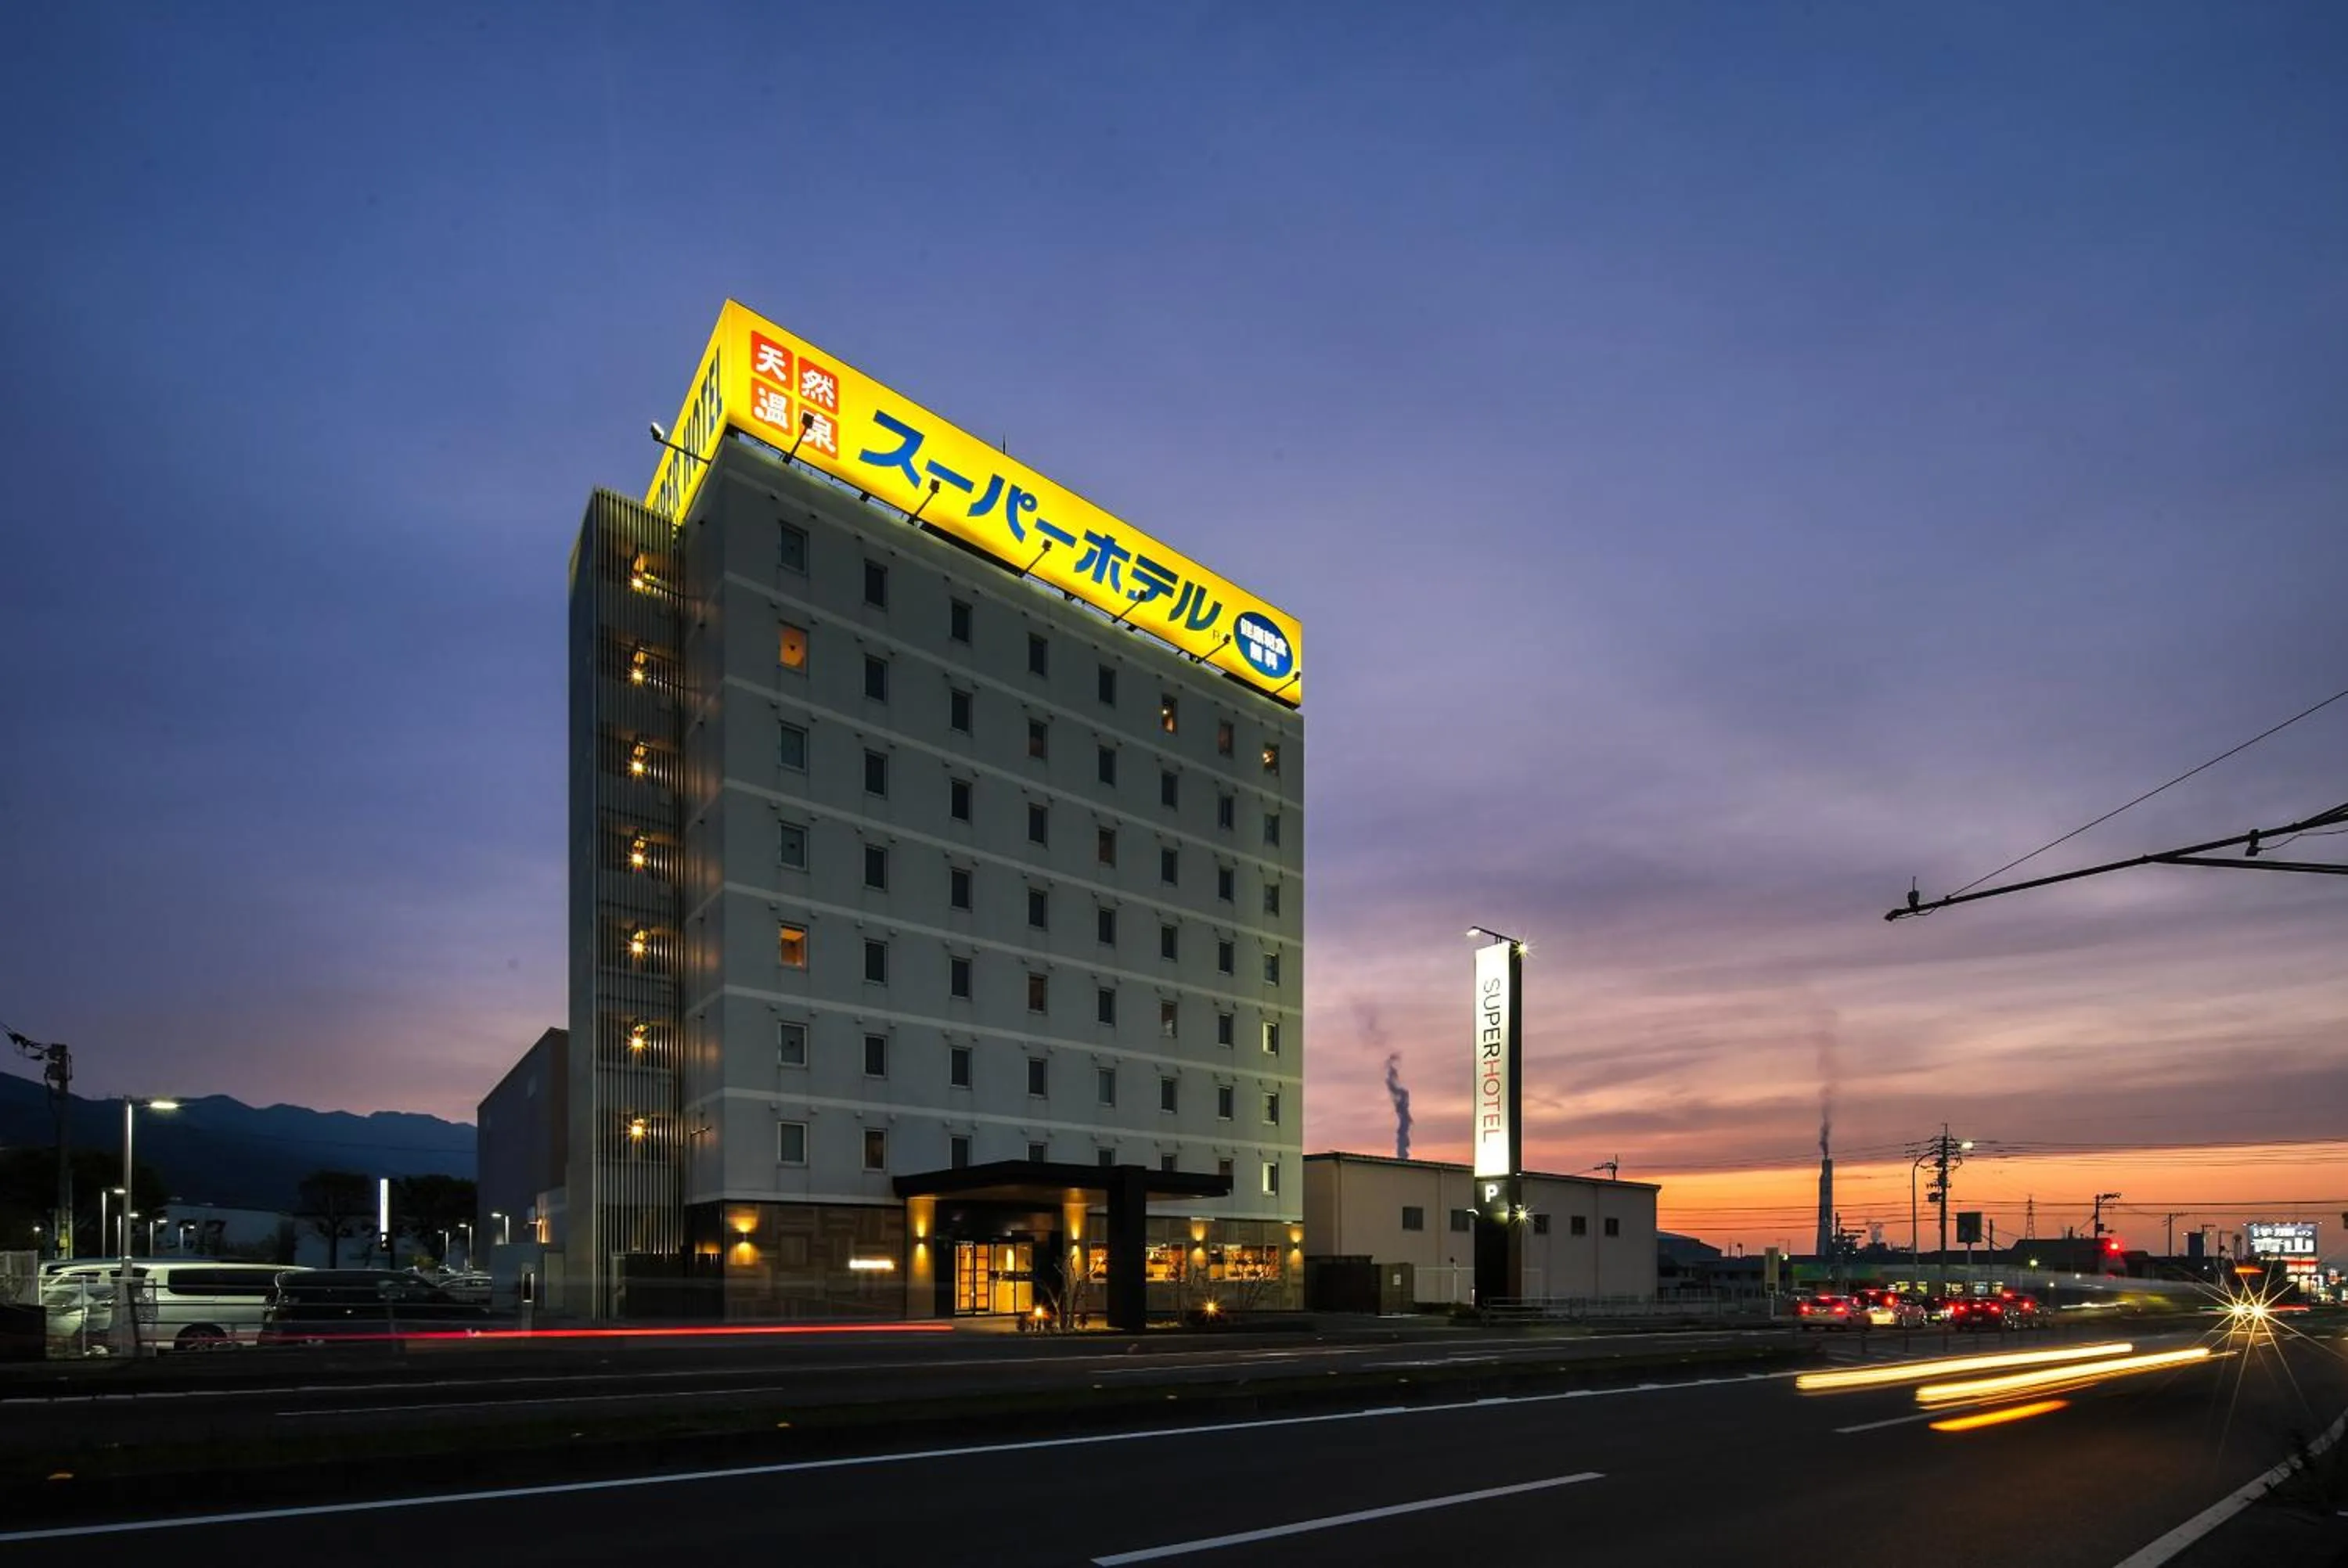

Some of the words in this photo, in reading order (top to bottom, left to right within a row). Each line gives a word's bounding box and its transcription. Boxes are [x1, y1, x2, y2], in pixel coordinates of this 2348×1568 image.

[755, 343, 835, 408] 天然
[683, 344, 722, 495] HOTEL
[754, 387, 837, 454] 温泉
[859, 409, 1223, 631] スーパーホテル
[1485, 1185, 1498, 1203] P
